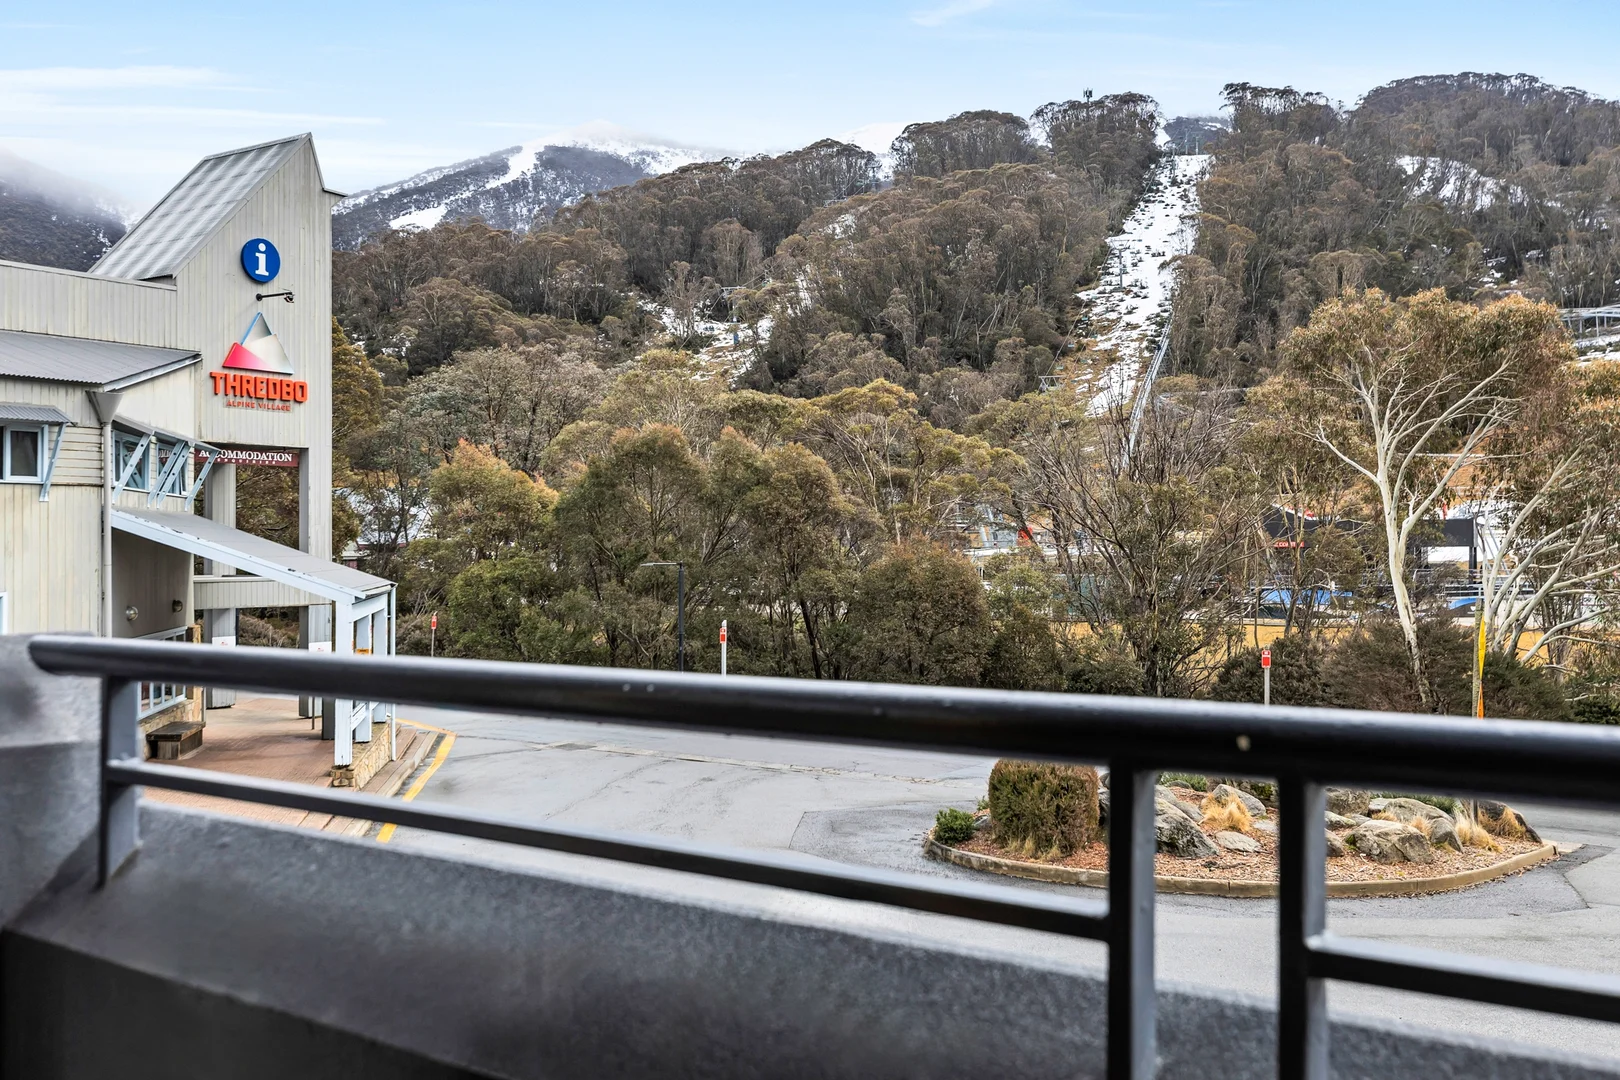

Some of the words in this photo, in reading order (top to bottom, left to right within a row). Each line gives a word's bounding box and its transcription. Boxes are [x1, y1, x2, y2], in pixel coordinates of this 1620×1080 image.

[255, 243, 269, 276] i
[209, 372, 308, 403] THREDBO
[226, 400, 255, 409] ALPINE
[258, 402, 291, 412] VILLAGE
[199, 449, 293, 462] AOMMODATION
